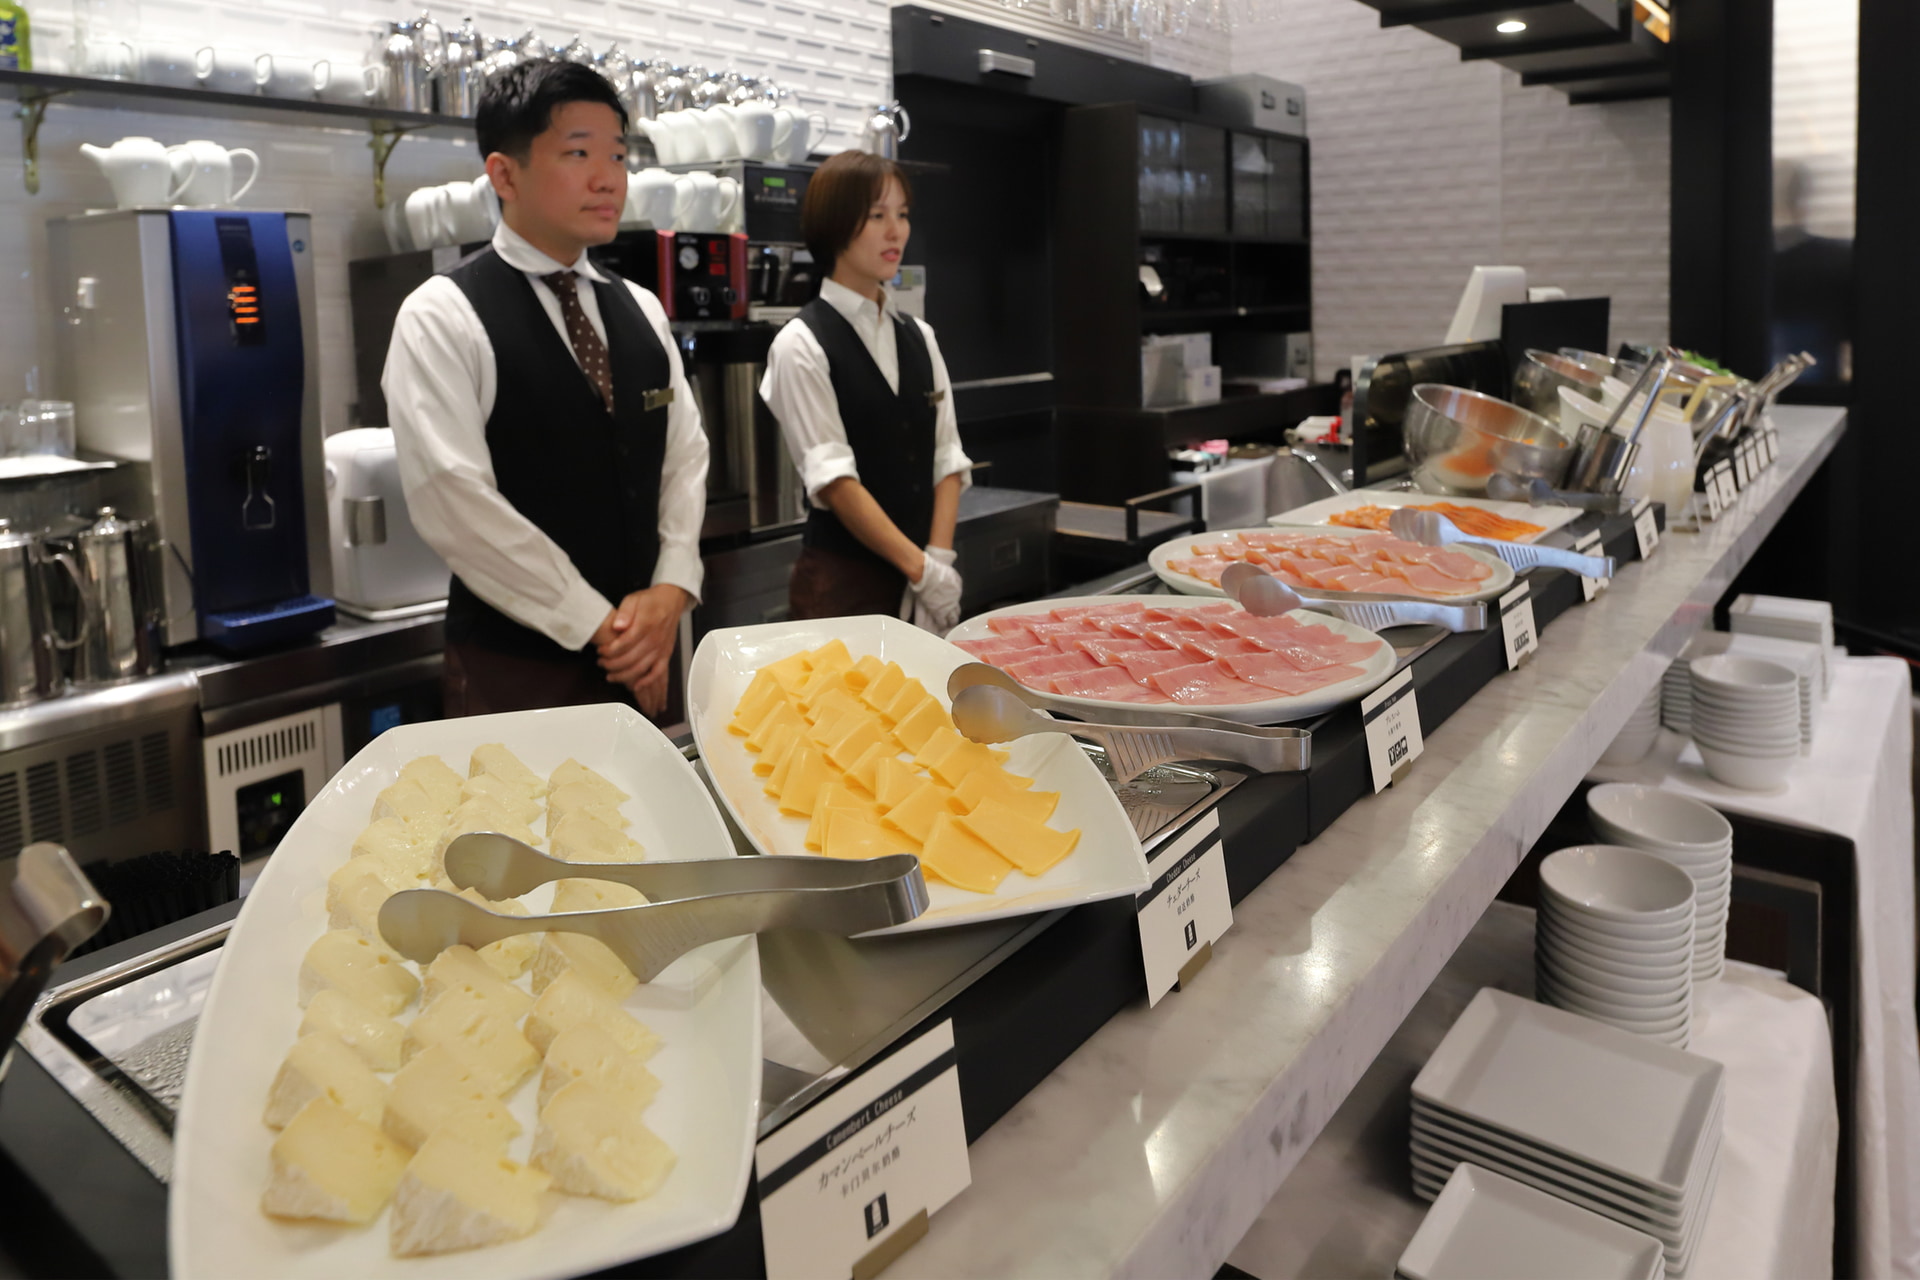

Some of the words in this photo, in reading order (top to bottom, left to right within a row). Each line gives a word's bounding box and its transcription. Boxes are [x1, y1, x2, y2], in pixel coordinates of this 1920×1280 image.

[1182, 853, 1196, 871] Cheese
[1167, 867, 1201, 909] チェダーチーズ
[826, 1112, 871, 1150] Camembert
[874, 1089, 903, 1117] Cheese
[818, 1106, 917, 1192] カマンベールチーズ
